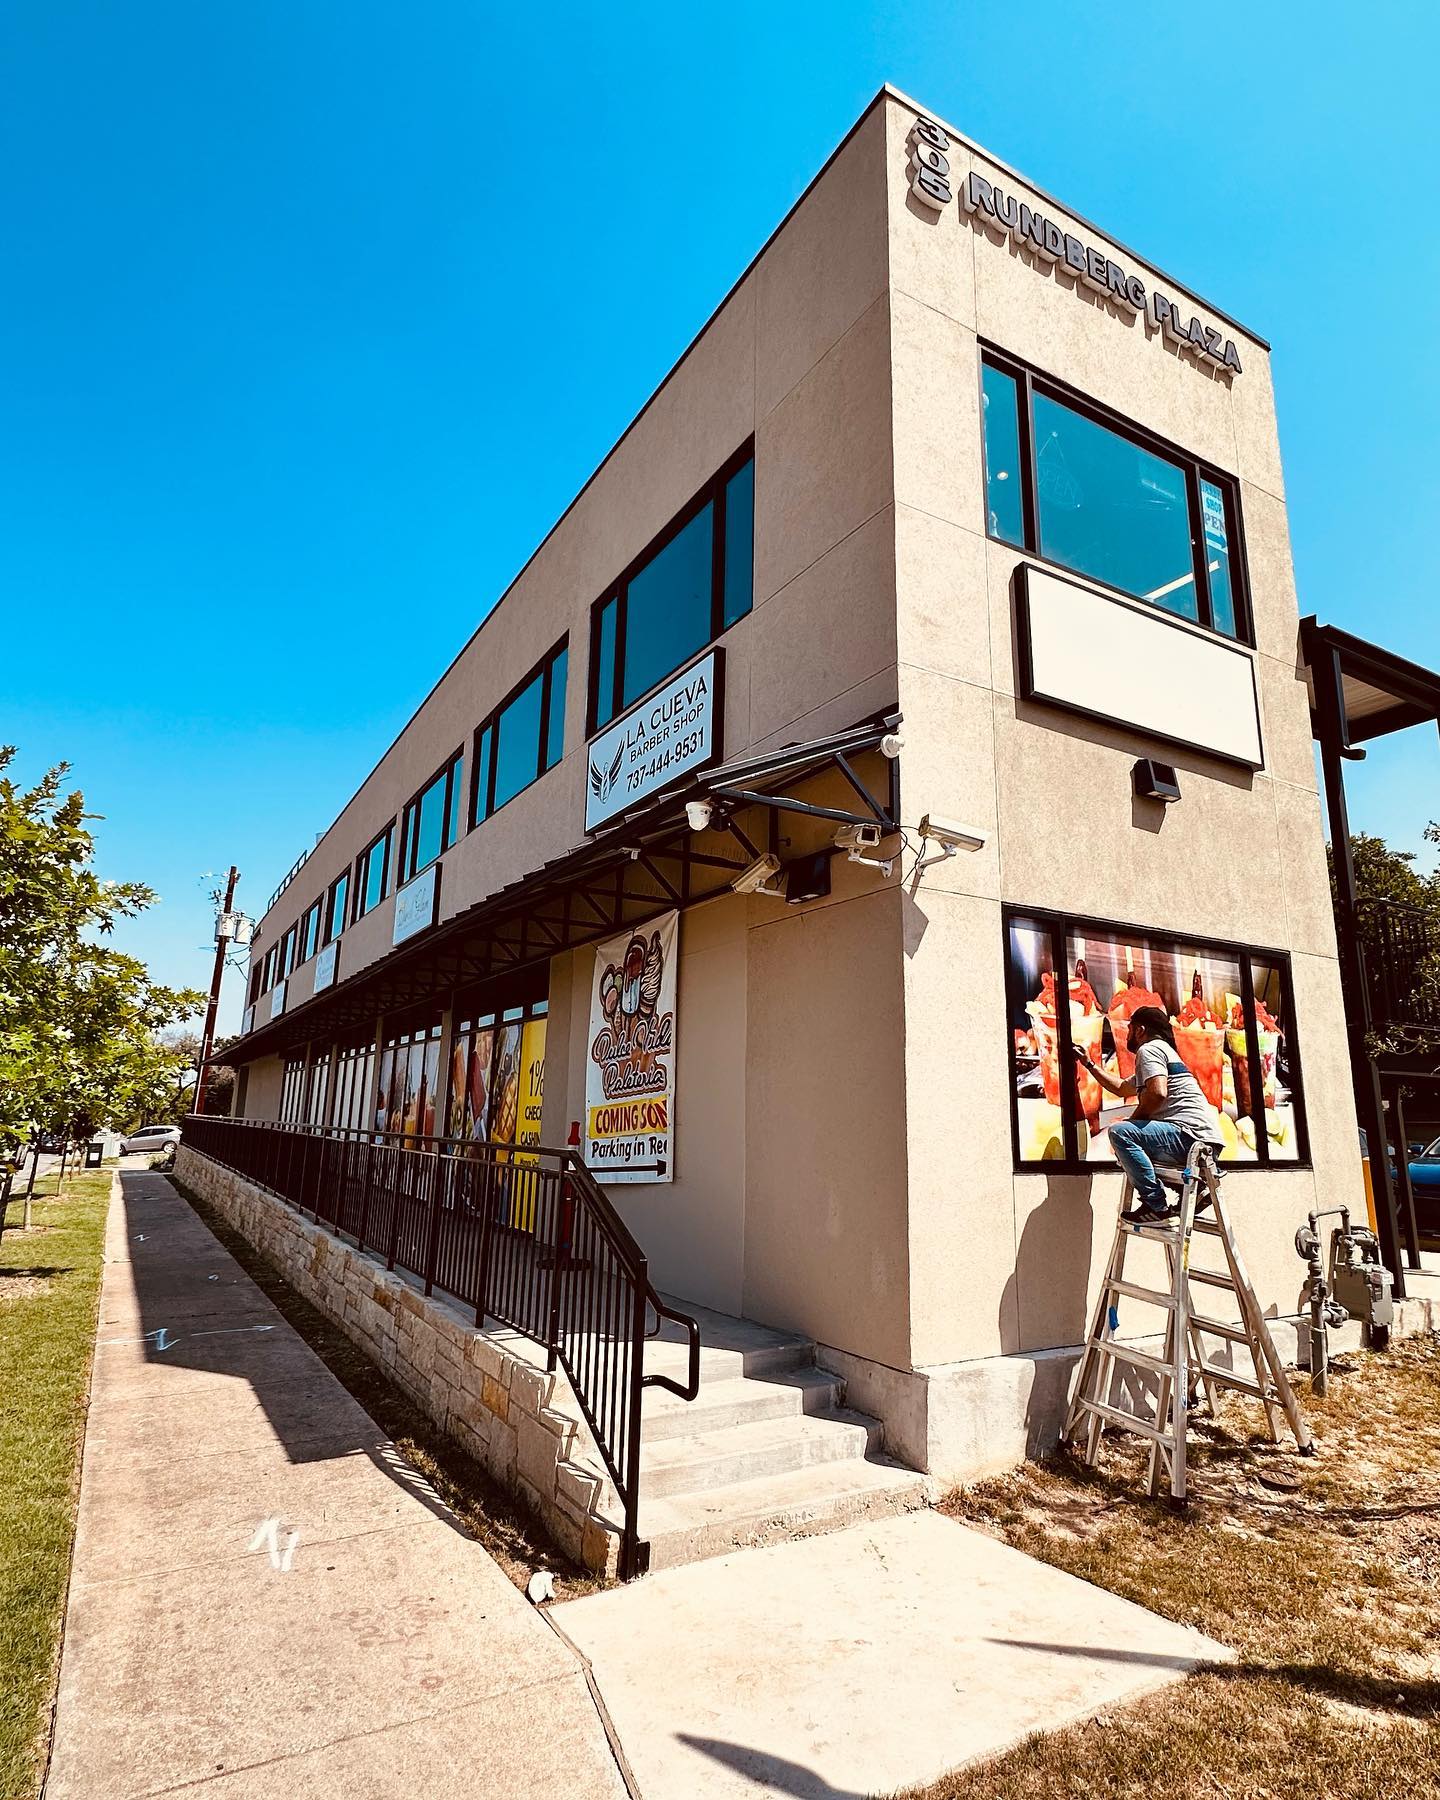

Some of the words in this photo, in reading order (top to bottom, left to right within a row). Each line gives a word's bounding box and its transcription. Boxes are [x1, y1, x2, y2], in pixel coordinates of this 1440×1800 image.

[914, 117, 953, 206] 305
[968, 171, 1146, 311] RUNDBERG
[1154, 291, 1243, 374] PLAZA
[626, 720, 646, 749] LA
[650, 675, 708, 727] CUEVA
[630, 726, 670, 763] BARBER
[673, 702, 705, 734] SHOP
[626, 726, 705, 793] 737-444-9531
[524, 1105, 542, 1122] CHEC
[595, 1104, 639, 1134] COMING
[591, 1137, 633, 1162] Parking
[633, 1135, 645, 1156] in
